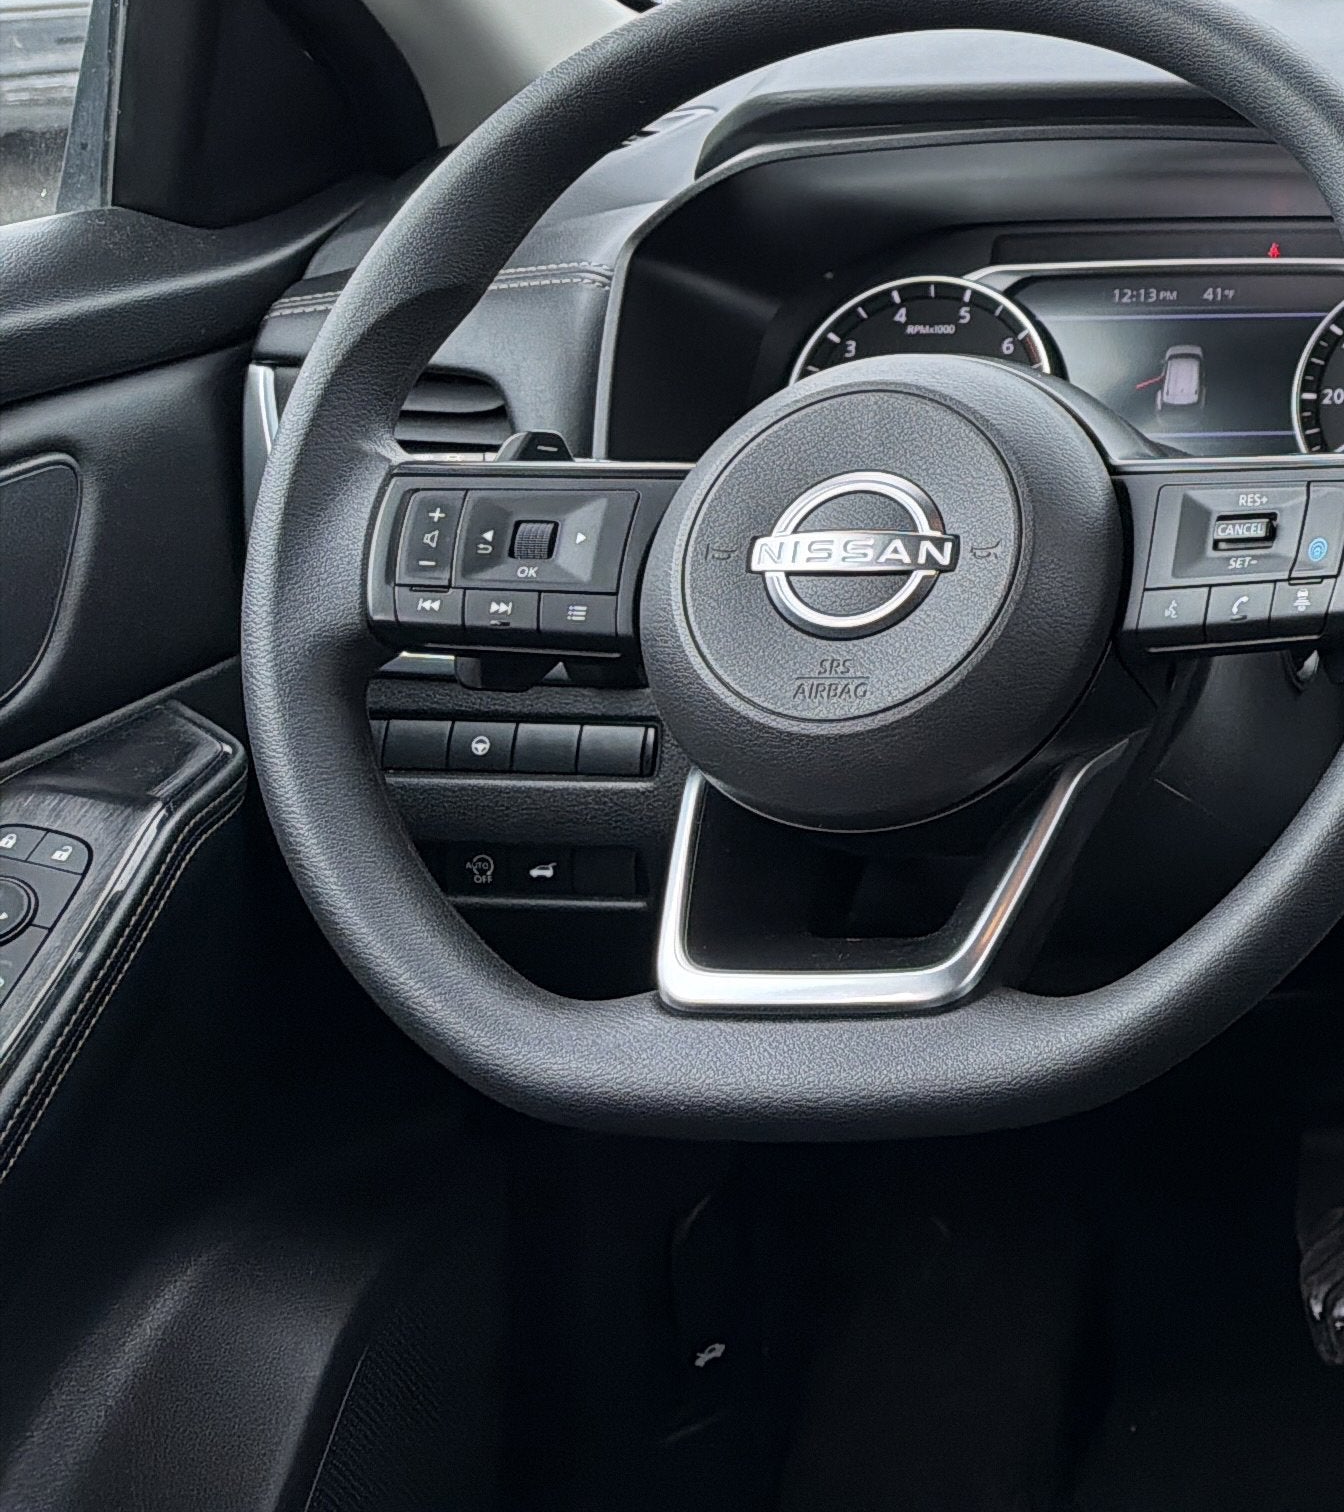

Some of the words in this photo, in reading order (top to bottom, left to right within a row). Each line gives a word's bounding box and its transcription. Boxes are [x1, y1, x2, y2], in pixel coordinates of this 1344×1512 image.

[1113, 288, 1157, 302] 12:13
[1160, 291, 1177, 300] PM
[893, 307, 907, 323] 4
[958, 307, 971, 323] 5
[844, 340, 857, 357] 3
[1001, 338, 1014, 355] 6
[1321, 389, 1344, 405] 20
[1239, 494, 1268, 507] RES+
[1217, 523, 1265, 536] CANCEL
[755, 538, 954, 568] NISSAN
[1228, 556, 1258, 570] SET-
[517, 566, 538, 579] OK
[818, 657, 852, 675] SRS
[793, 682, 868, 701] AIRBAG
[474, 875, 493, 884] OFF
